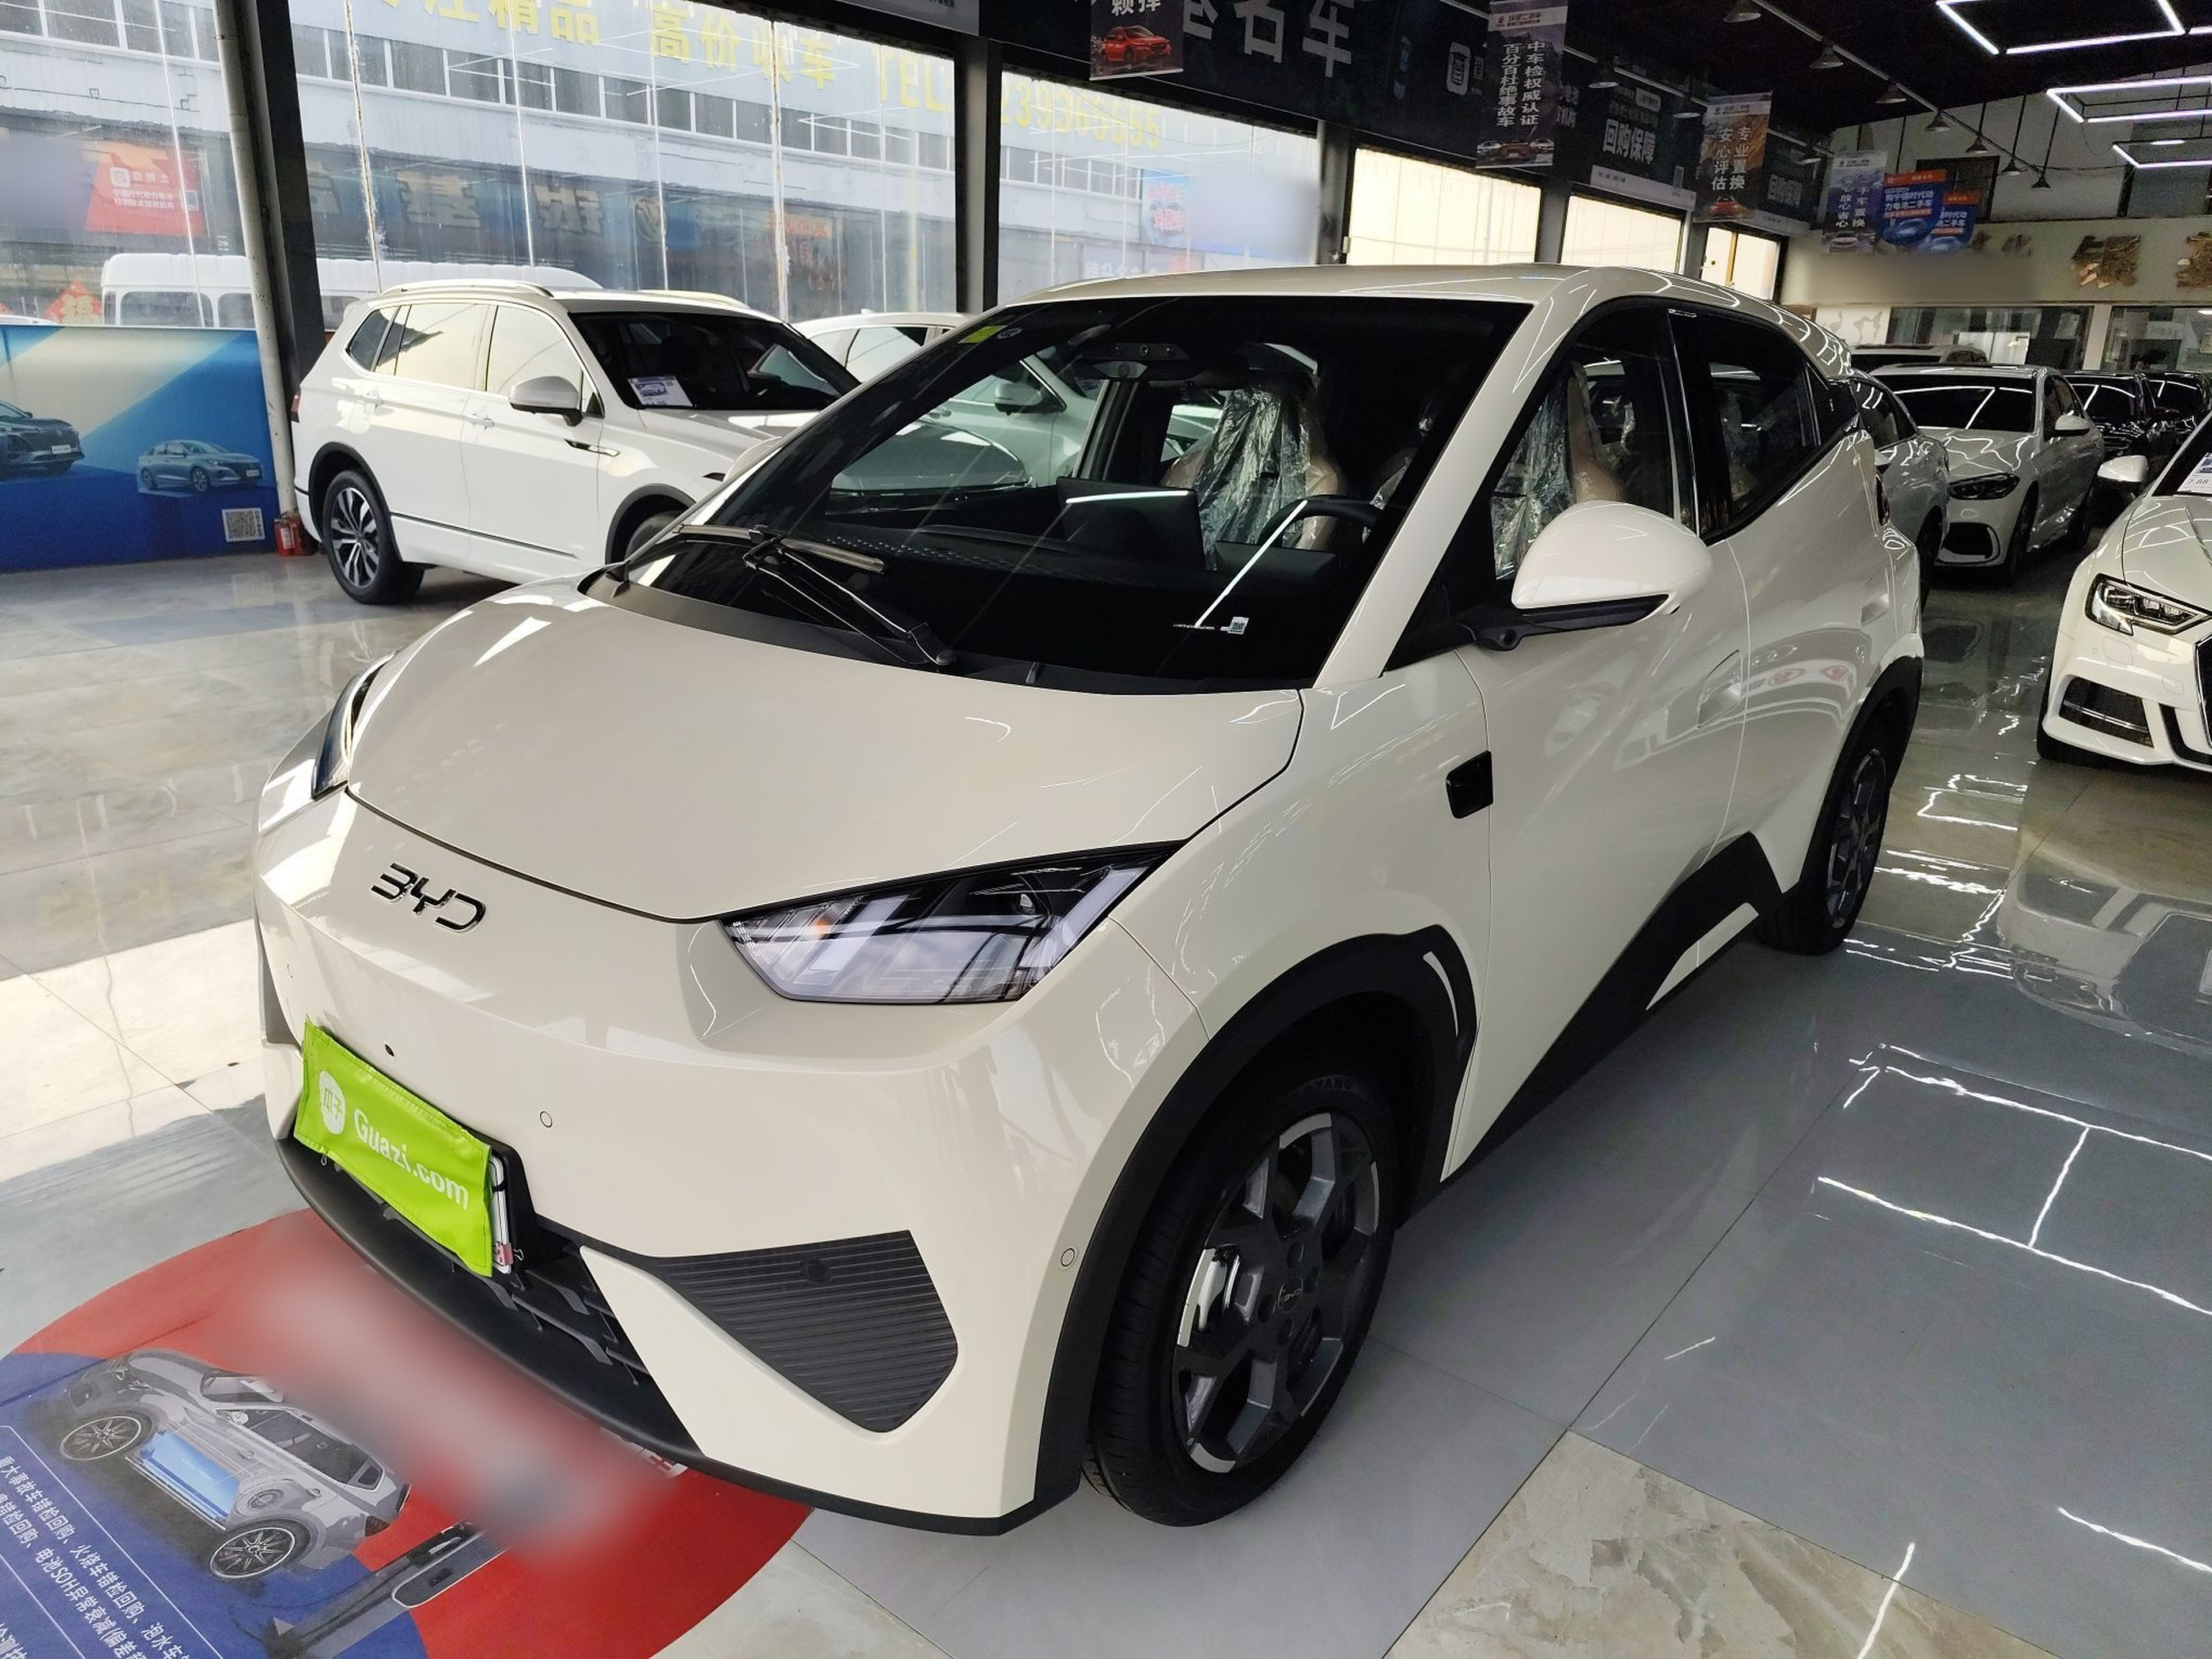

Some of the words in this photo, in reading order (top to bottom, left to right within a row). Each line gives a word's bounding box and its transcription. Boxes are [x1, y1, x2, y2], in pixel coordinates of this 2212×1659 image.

[651, 3, 836, 89] 高价收车
[1520, 41, 1546, 126] 中车检权威认证
[1496, 43, 1523, 127] 百分百杜绝事故车
[1603, 119, 1657, 164] 回购保障
[1711, 127, 1734, 191] 安心评估
[1729, 126, 1753, 190] 专业置换
[370, 862, 486, 933] BYD
[354, 1109, 469, 1211] Guazi.com
